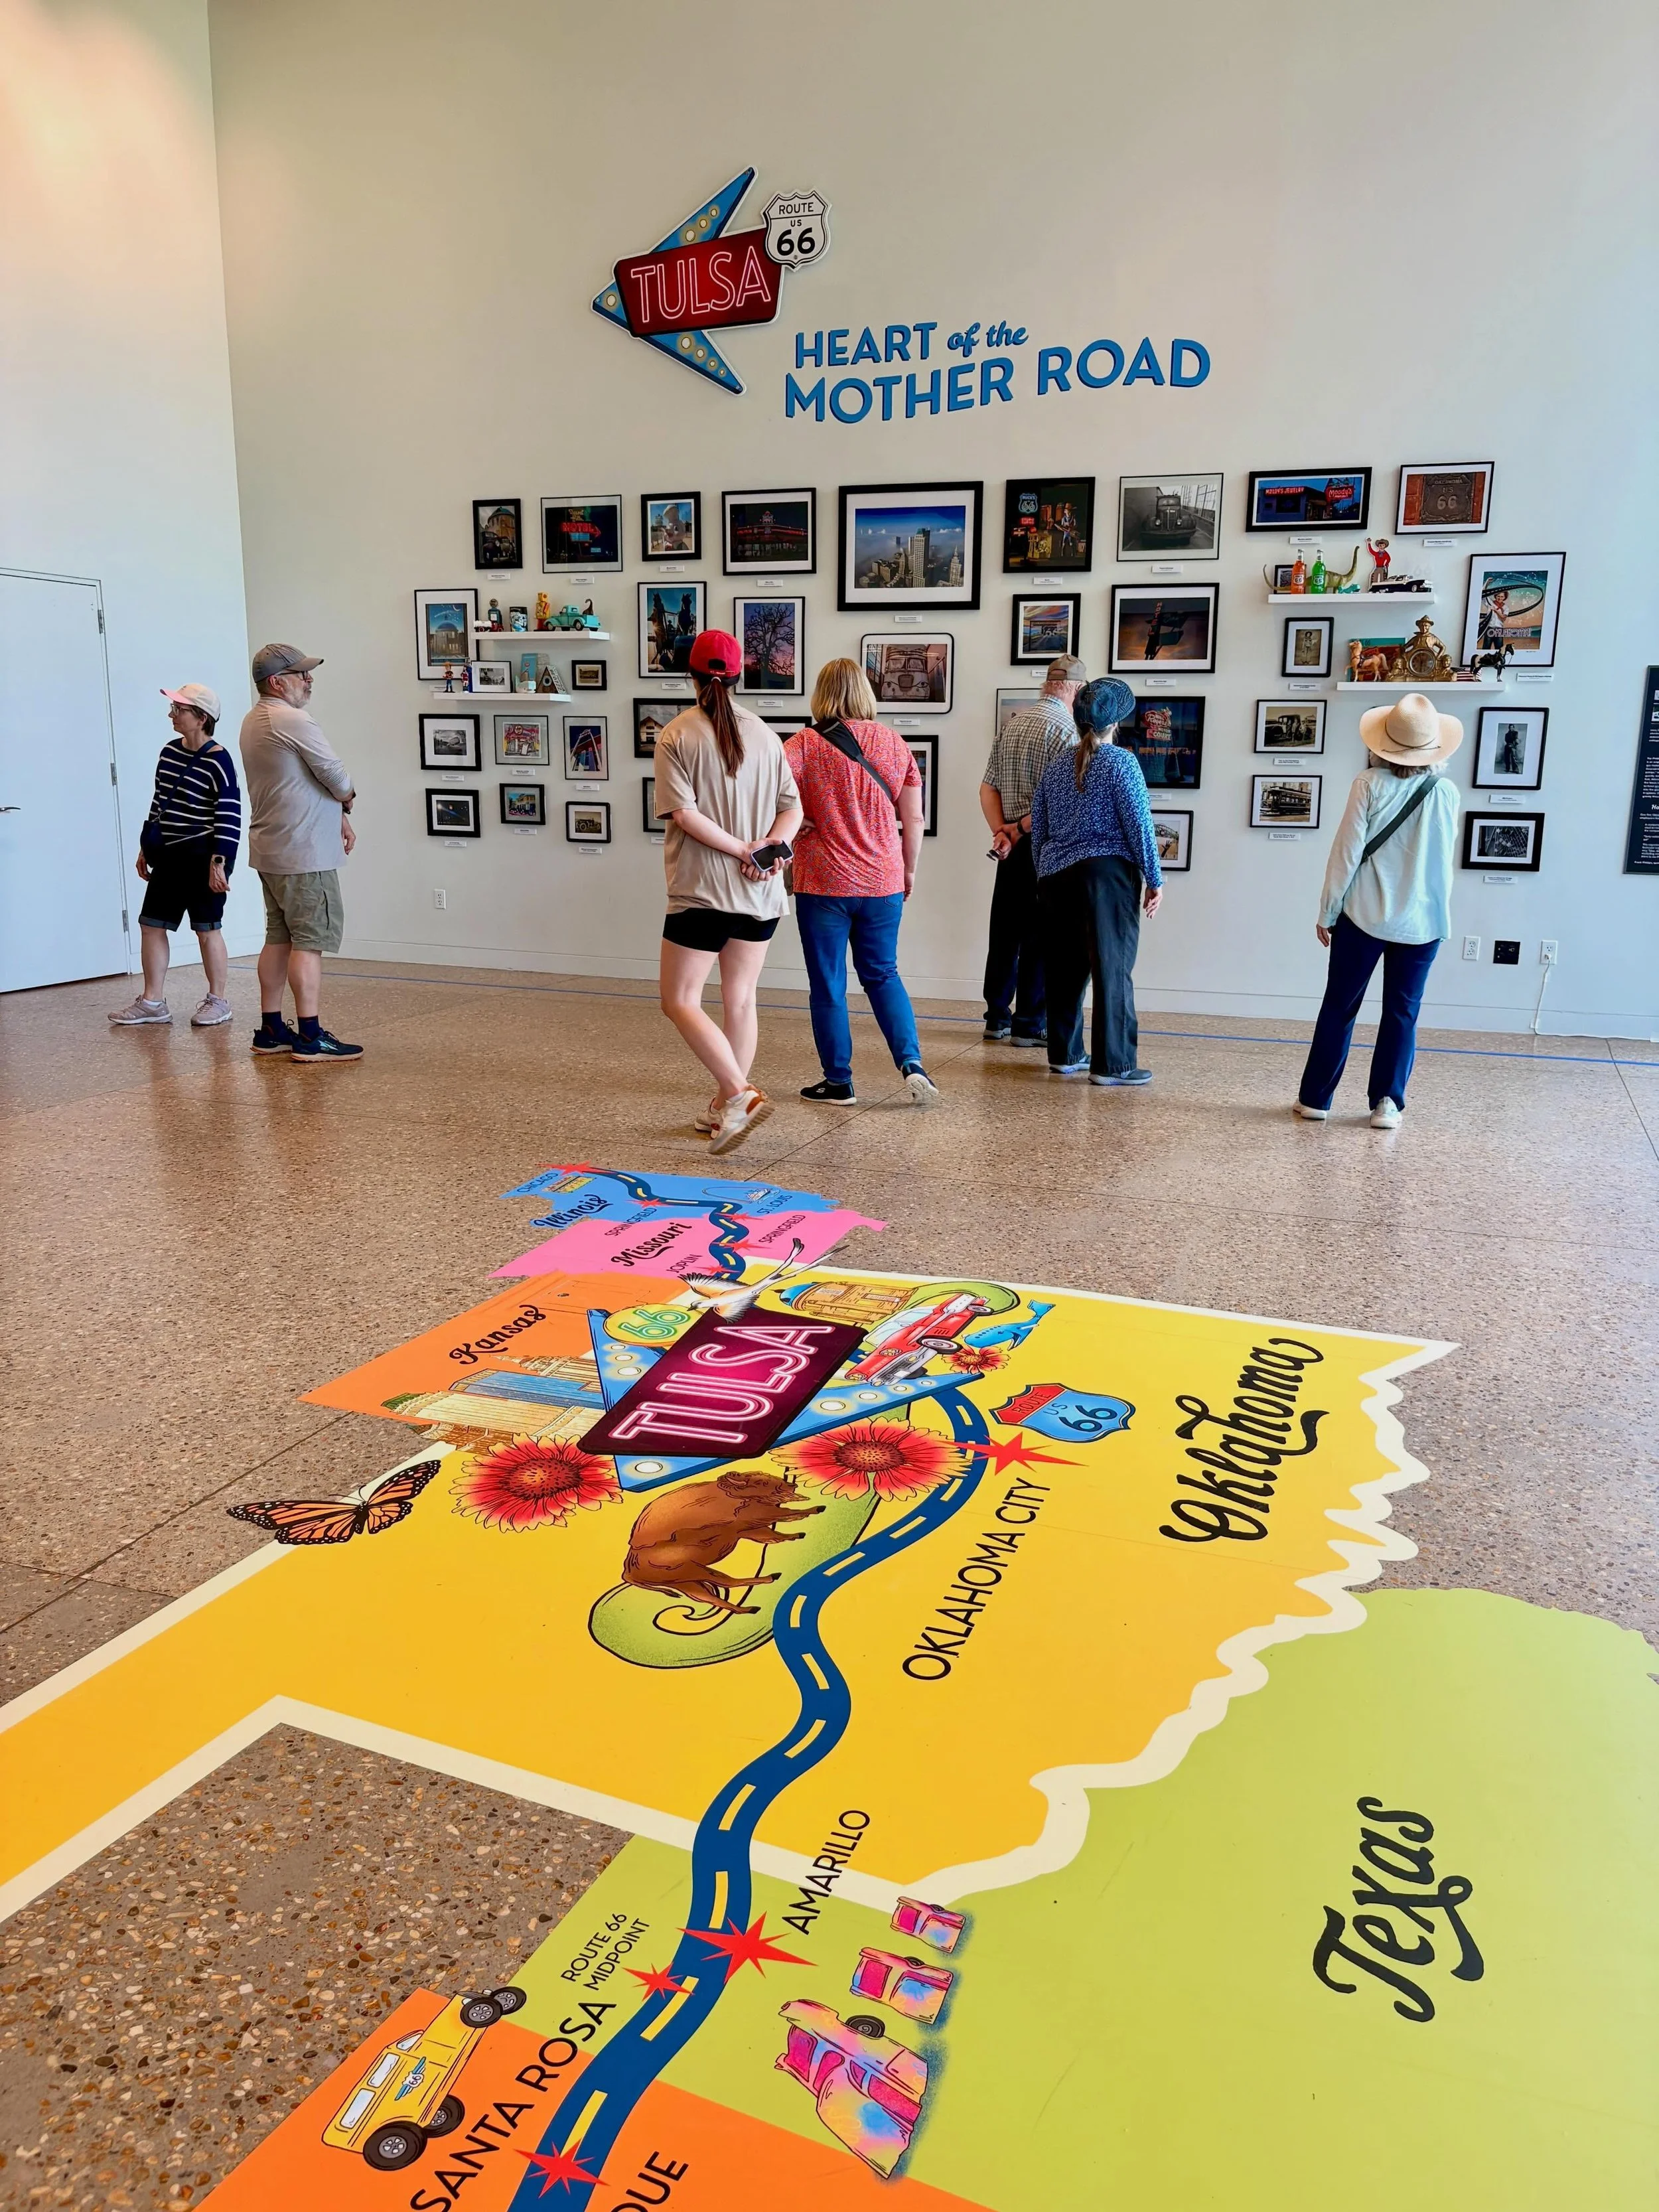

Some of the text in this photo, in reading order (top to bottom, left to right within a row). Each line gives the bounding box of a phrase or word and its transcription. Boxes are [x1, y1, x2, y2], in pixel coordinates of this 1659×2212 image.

[779, 202, 814, 214] ROUTE
[776, 227, 816, 256] 66
[631, 246, 771, 323] TULSA
[796, 321, 1029, 368] HEART of the
[786, 336, 1210, 424] MOTHER ROAD
[1021, 500, 1035, 511] 66
[1437, 495, 1457, 510] 66
[517, 1173, 558, 1193] CHICAGO
[534, 1195, 613, 1228] Illinois
[605, 1208, 657, 1236] SPRINGFIELD
[758, 1215, 806, 1243] SPRINGFIELD
[611, 1222, 692, 1266] Missouri
[666, 1254, 702, 1273] JOPLIN
[449, 1305, 546, 1364] Kansas
[617, 1307, 691, 1340] 66
[610, 1323, 835, 1445] TULSA
[1012, 1392, 1052, 1414] ROUTE
[1043, 1403, 1068, 1416] US
[1058, 1405, 1118, 1432] 66
[1159, 1338, 1330, 1542] Oklahoma
[902, 1477, 1050, 1680] OKLAHOMA CITY
[782, 1810, 870, 1935] AMARILLO
[1313, 1797, 1484, 2022] Texas
[561, 1913, 626, 1982] ROUTE 66
[583, 1918, 650, 1990] MIDPOINT
[409, 2076, 421, 2085] 66
[410, 2002, 616, 2212] SANTA ROSA
[610, 2151, 689, 2212] UE
